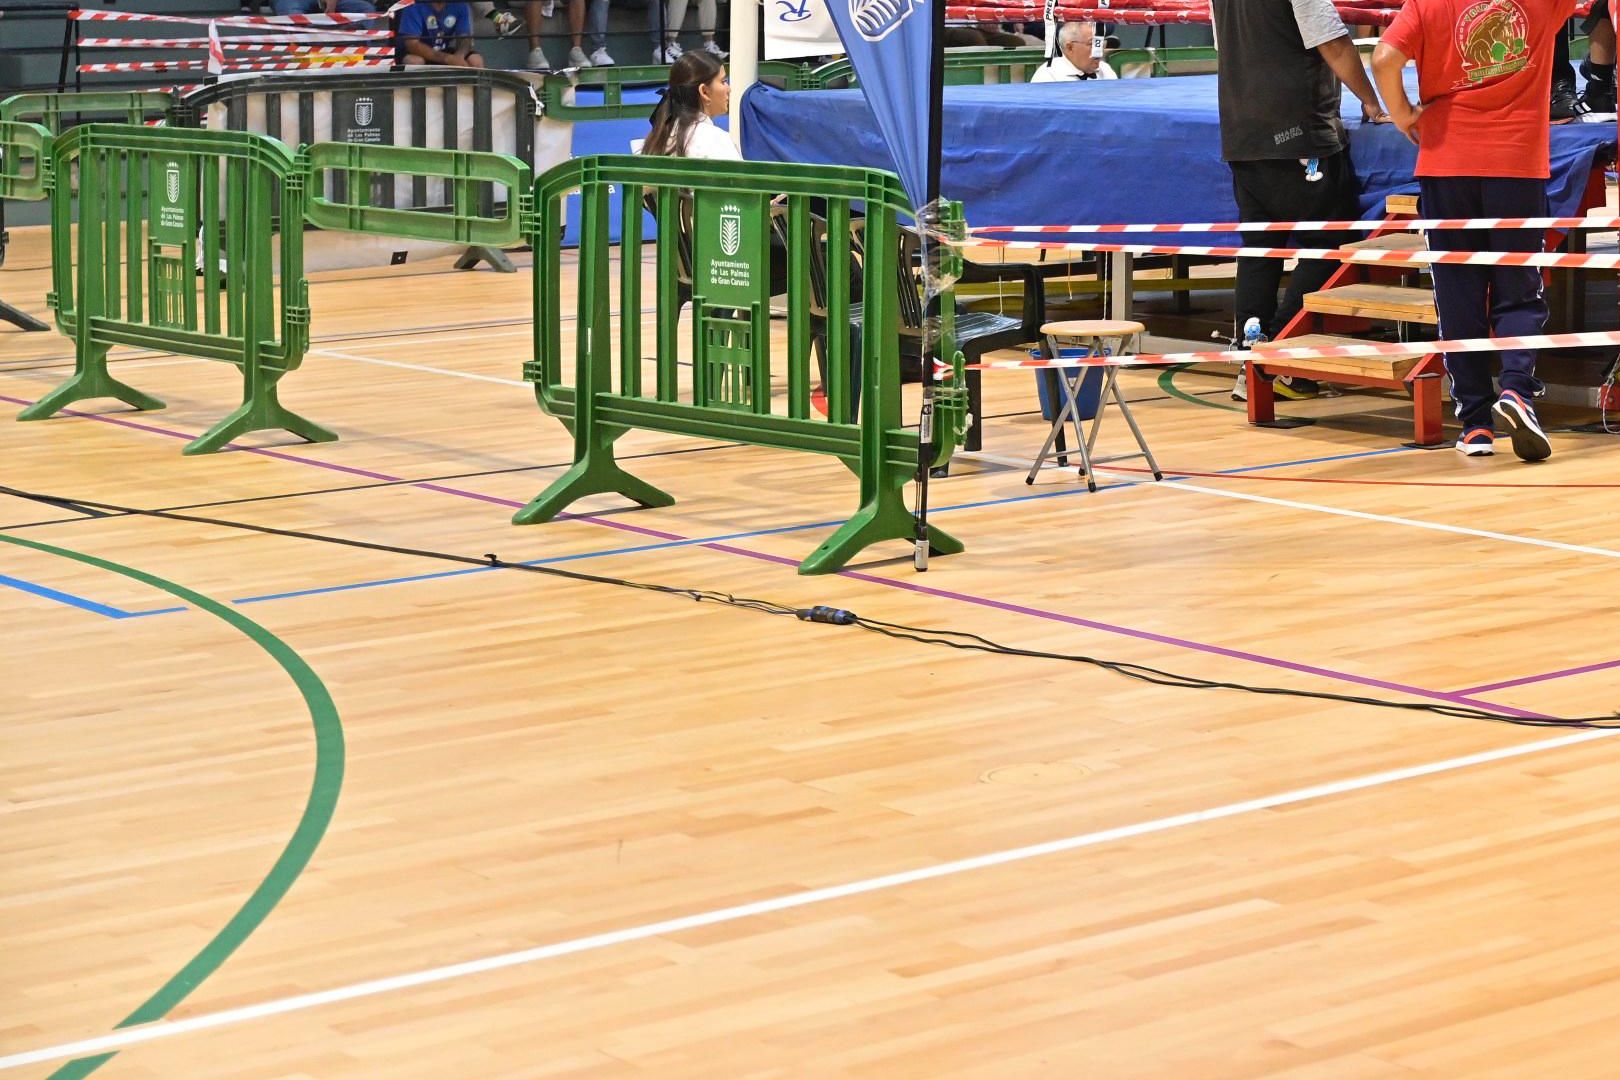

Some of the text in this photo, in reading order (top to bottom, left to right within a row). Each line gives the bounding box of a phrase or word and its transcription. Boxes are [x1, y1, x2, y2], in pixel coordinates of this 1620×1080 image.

[711, 259, 750, 269] Ayuntamiento
[720, 268, 729, 277] Las
[731, 269, 750, 278] Palmas
[711, 276, 750, 287] de Gran Canaria
